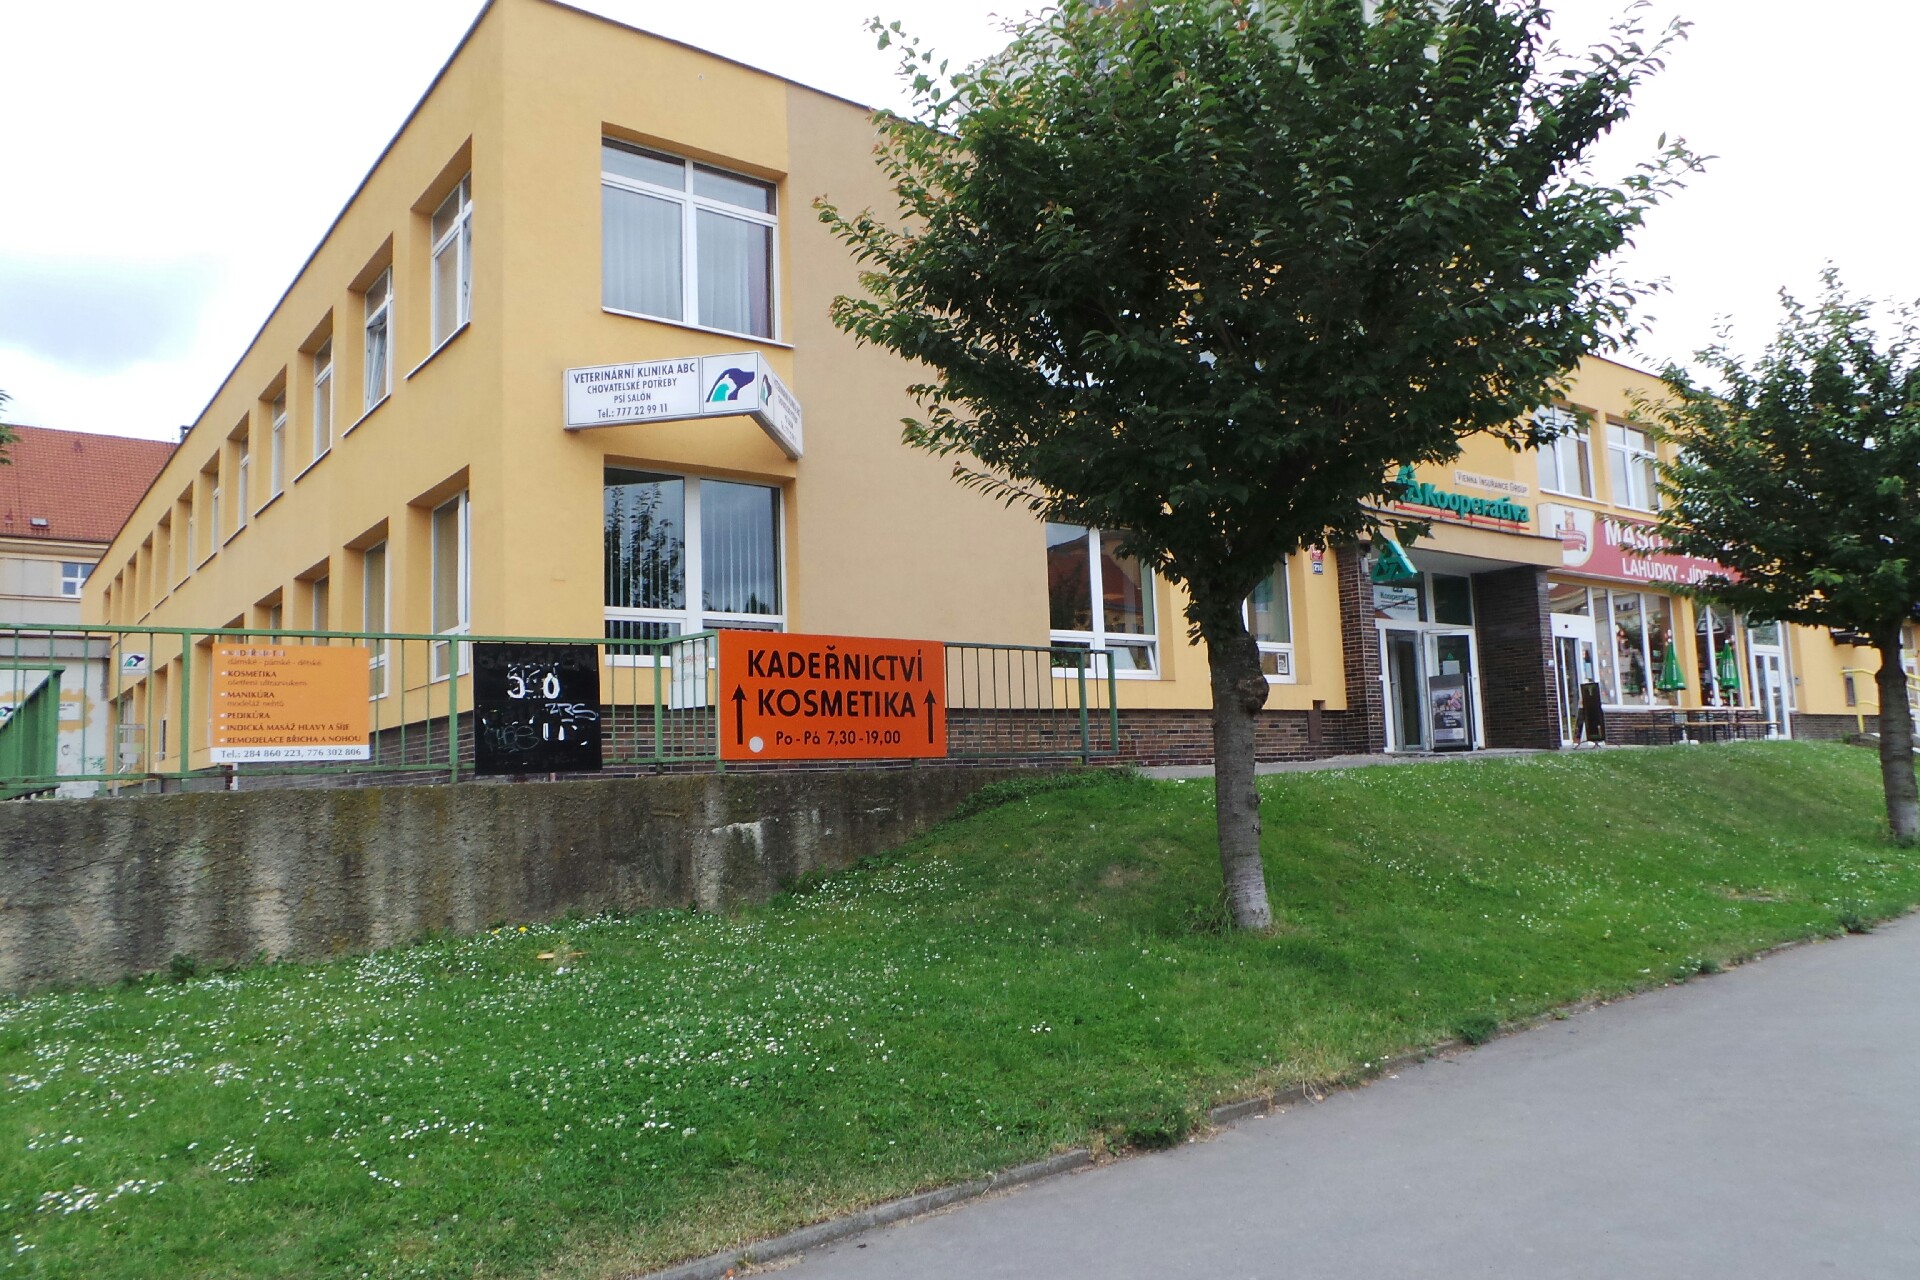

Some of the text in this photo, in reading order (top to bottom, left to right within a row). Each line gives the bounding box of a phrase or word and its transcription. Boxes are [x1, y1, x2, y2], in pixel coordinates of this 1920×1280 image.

[574, 362, 695, 383] VETERINÁRNÍ KLINIKA ABC
[587, 377, 677, 394] CHOVATELSKÉ POTŘEBY
[613, 392, 651, 404] PSÍ SALÓN
[598, 403, 668, 418] Tel.: 777 22 99 11
[1622, 554, 1678, 582] LAHŮDKY
[747, 645, 923, 682] KADEŘNICTVÍ
[228, 670, 277, 678] KOSMETIKA
[758, 689, 916, 718] KOSMETIKA
[266, 722, 296, 731] MASÁŽ
[226, 736, 284, 744] REMODELACE
[286, 734, 319, 743] BŘICHA
[221, 750, 240, 759] Tel.:
[243, 750, 260, 758] 284
[263, 749, 281, 757] 860
[307, 748, 324, 757] 776
[327, 748, 343, 756] 302
[345, 748, 361, 756] 806
